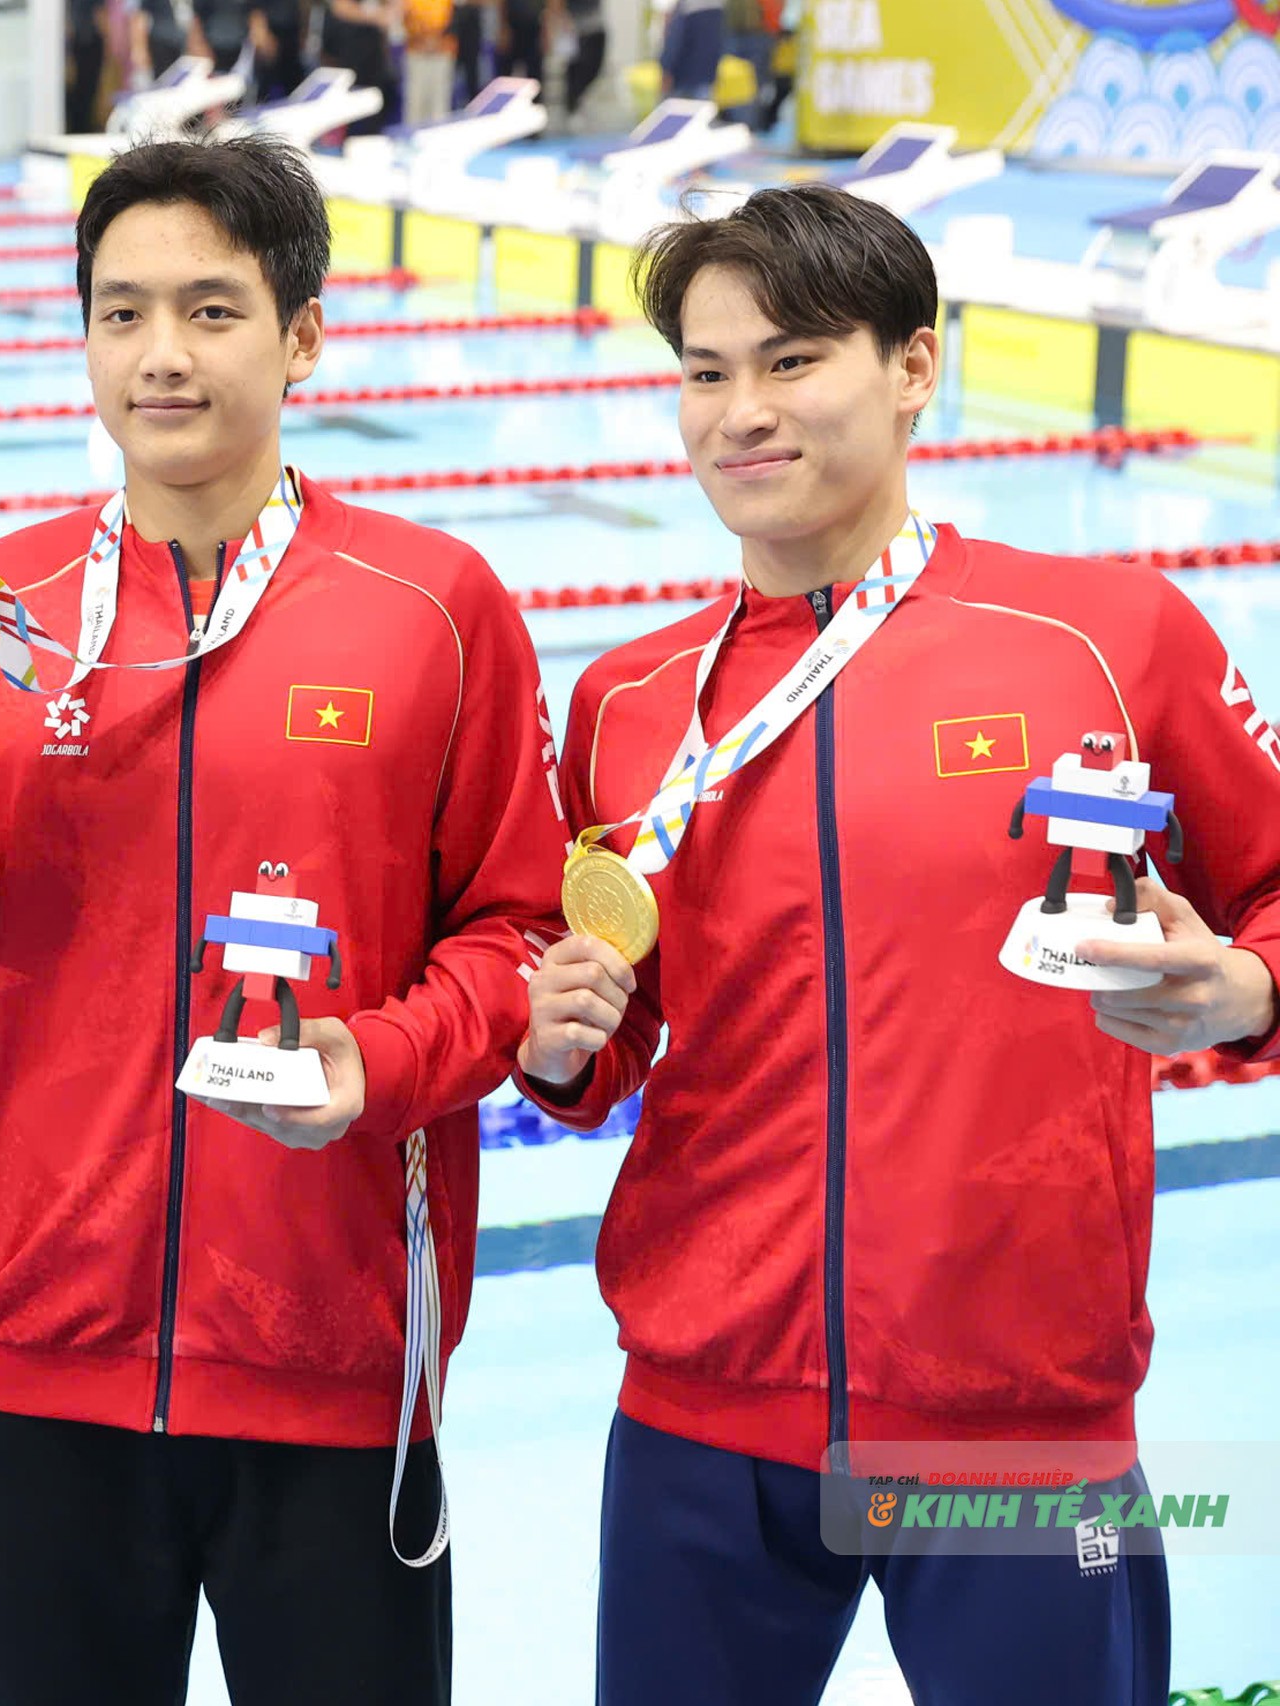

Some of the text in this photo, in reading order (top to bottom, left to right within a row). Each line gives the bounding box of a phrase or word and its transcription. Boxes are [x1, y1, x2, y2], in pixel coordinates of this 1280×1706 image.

[786, 653, 834, 703] THAILAND
[40, 744, 90, 757] JOGARBOLA
[1037, 960, 1066, 975] 2025
[211, 1063, 275, 1082] THAILAND
[206, 1075, 232, 1087] 2025
